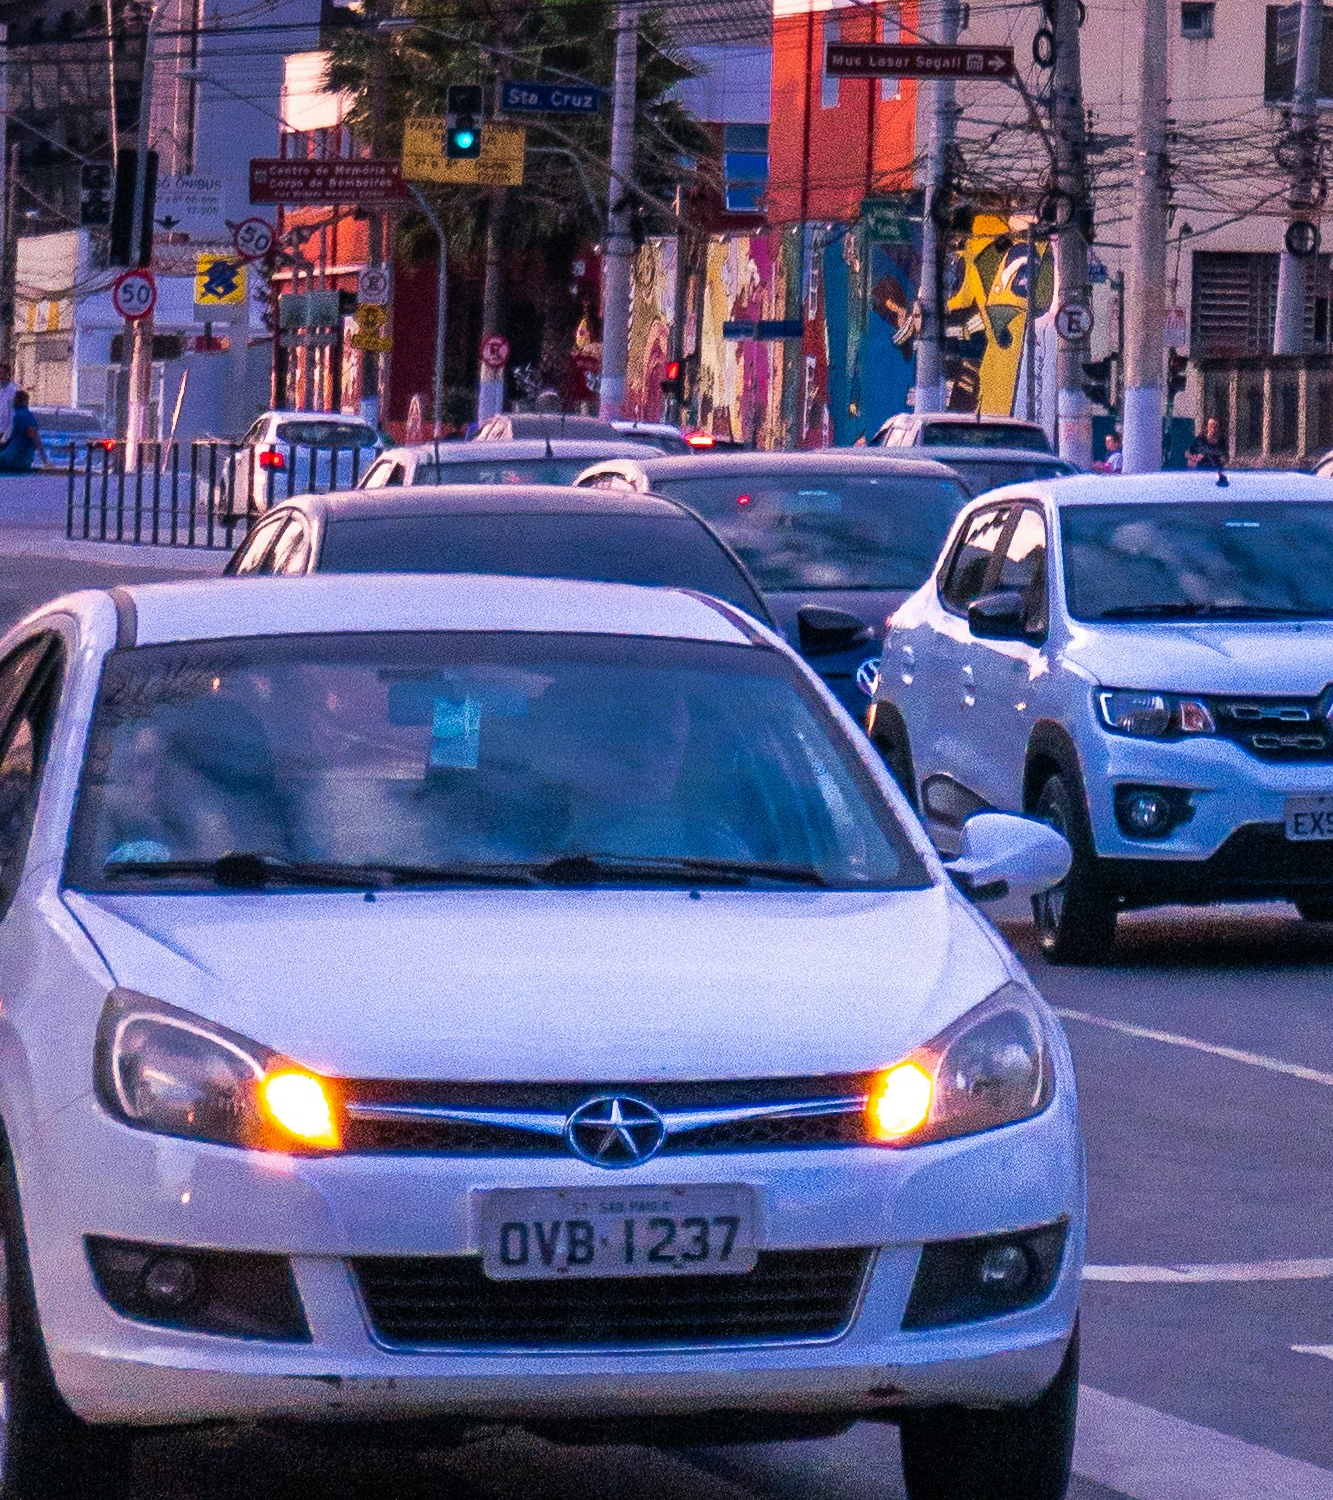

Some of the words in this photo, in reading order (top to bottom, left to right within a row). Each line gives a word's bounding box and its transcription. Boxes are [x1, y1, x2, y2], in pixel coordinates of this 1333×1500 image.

[508, 89, 543, 106] Sta.
[551, 91, 593, 108] Cruz
[269, 165, 310, 176] Centro
[315, 165, 329, 175] de
[334, 164, 386, 176] Memória
[328, 178, 393, 189] Bombeiros
[239, 226, 269, 249] 50
[121, 285, 151, 304] 50
